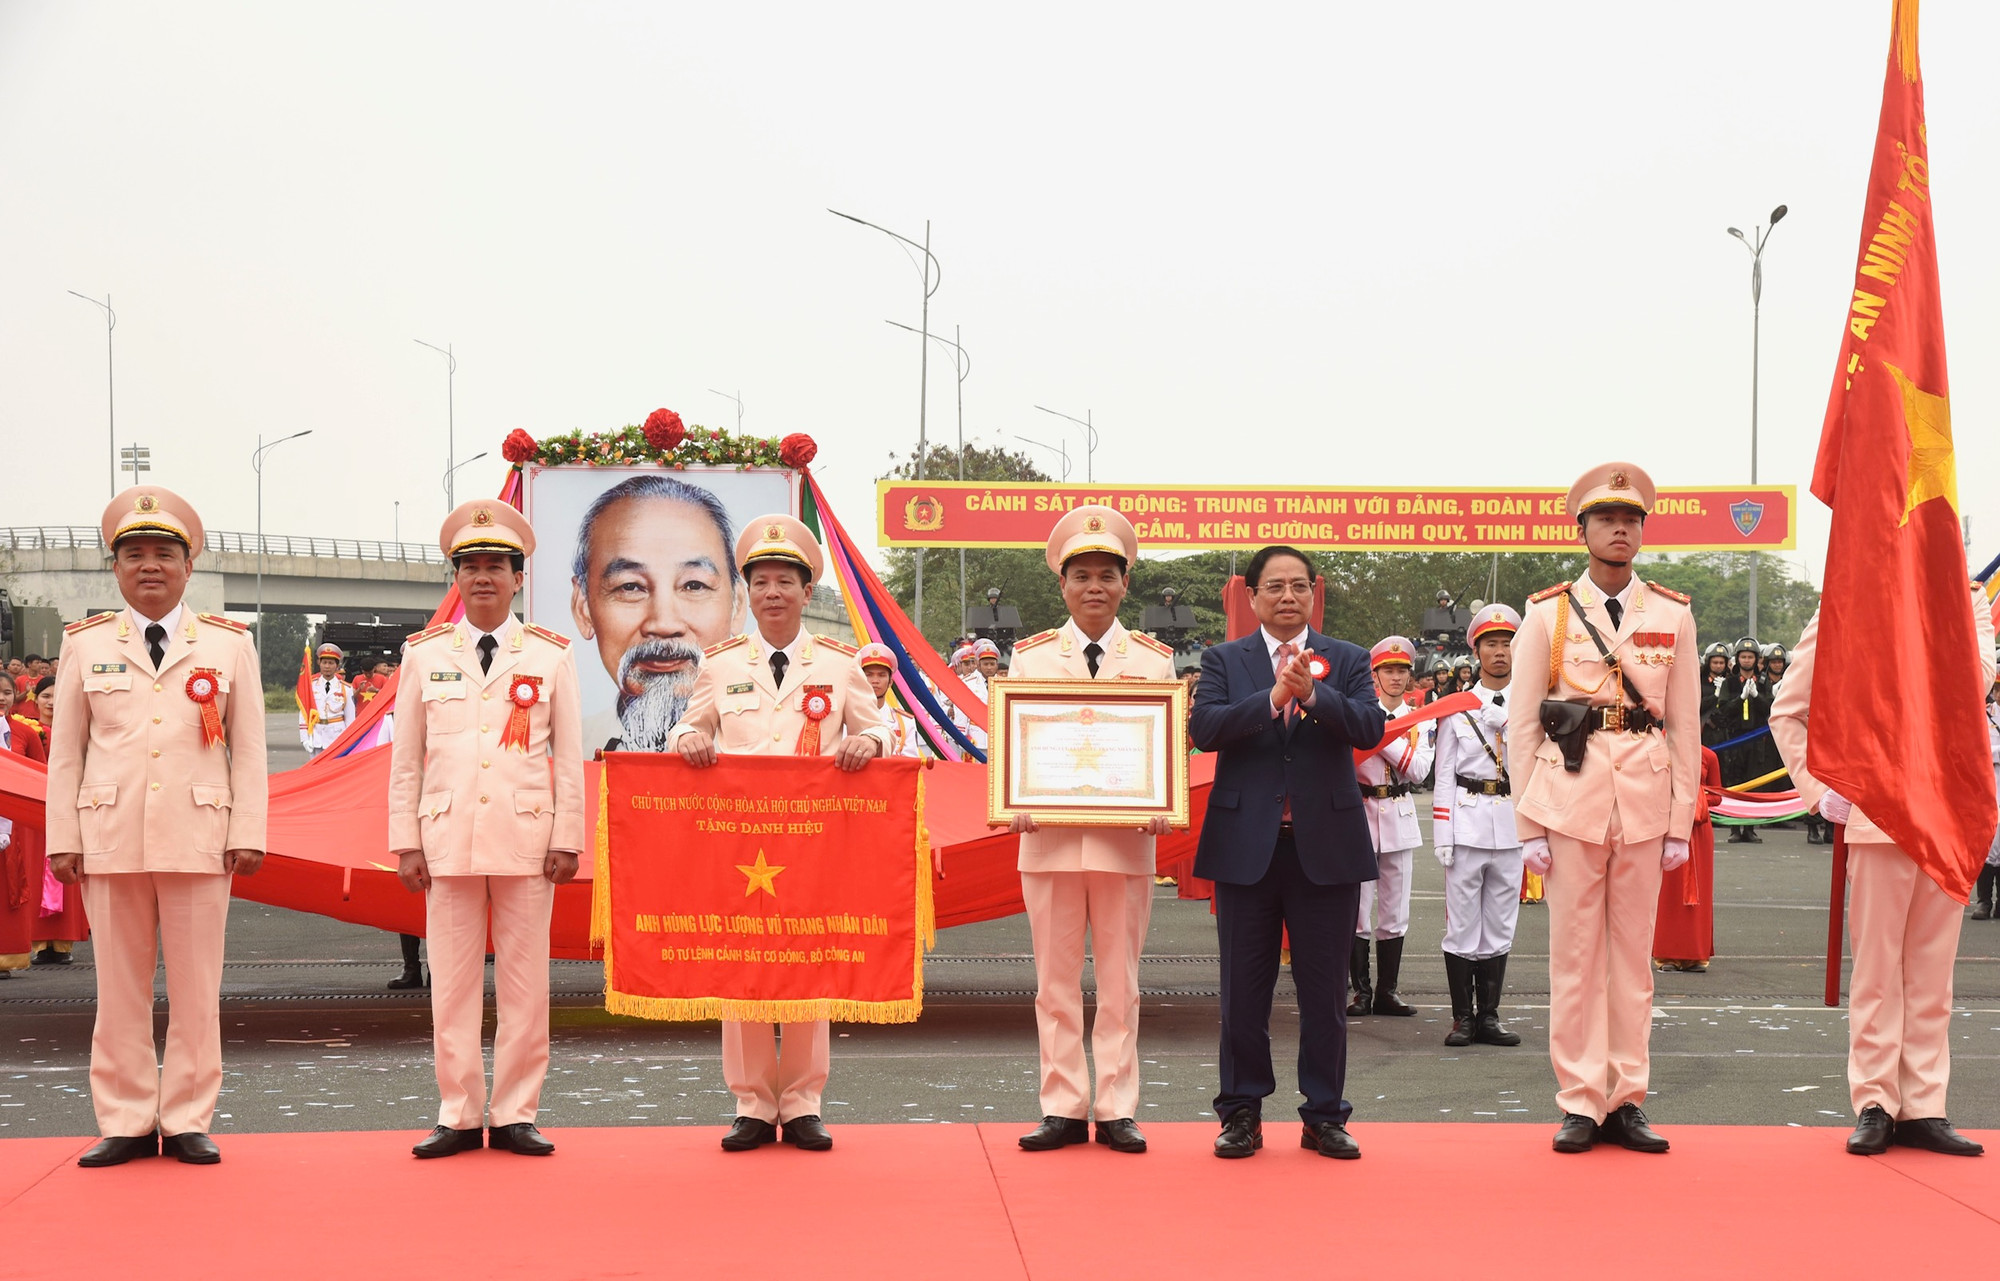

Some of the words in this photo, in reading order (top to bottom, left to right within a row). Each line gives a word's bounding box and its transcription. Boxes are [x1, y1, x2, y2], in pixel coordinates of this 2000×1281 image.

[1859, 200, 1918, 287] NINH
[1850, 288, 1887, 341] AN
[965, 490, 1027, 512] CẢNH
[1034, 493, 1076, 512] SÁT
[1119, 493, 1187, 515] ĐỘNG:
[1194, 497, 1267, 514] TRUNG
[1274, 495, 1347, 514] THÀNH
[1354, 496, 1389, 514] VỚI
[1396, 494, 1464, 516] ĐẢNG,
[1471, 496, 1531, 515] ĐOÀN
[1539, 495, 1567, 515] KẾ
[1647, 497, 1707, 516] ƠNG,
[1134, 518, 1191, 540] CẢM,
[1198, 520, 1250, 538] KIÊN
[1257, 520, 1340, 541] CƯỜNG,
[1347, 521, 1415, 540] CHÍNH
[1422, 524, 1468, 542] QUY,
[1474, 525, 1525, 540] TINH
[1532, 525, 1578, 541] NHU
[631, 791, 652, 809] CHỦ
[653, 797, 677, 813] TỊCH
[678, 793, 705, 810] NƯỚC
[707, 793, 733, 814] CỘNG
[735, 796, 755, 813] HÒA
[756, 796, 769, 813] XÃ
[771, 796, 788, 816] HỘI
[790, 794, 810, 813] CHỦ
[812, 795, 842, 812] NGHĨA
[843, 794, 865, 815] VIỆT
[866, 800, 887, 813] NAM
[696, 817, 737, 833] TẶNG
[741, 823, 784, 834] DANH
[787, 820, 824, 836] HIỆU
[635, 914, 660, 933] ANH
[662, 912, 697, 933] HÙNG
[699, 914, 722, 936] LỰC
[724, 914, 764, 938] LƯỢNG
[766, 914, 782, 935] VŨ
[784, 917, 825, 935] TRANG
[826, 912, 860, 934] NHÂN
[862, 914, 888, 935] DÂN
[661, 946, 675, 964] BỘ
[676, 947, 689, 961] TƯ
[691, 945, 714, 964] LỆNH
[716, 944, 742, 961] CẢNH
[744, 947, 761, 963] SÁT
[763, 949, 777, 963] CƠ
[778, 947, 809, 966] ĐỘNG,
[810, 947, 823, 966] BỘ
[825, 945, 849, 962] CÔNG
[851, 950, 865, 963] AN
